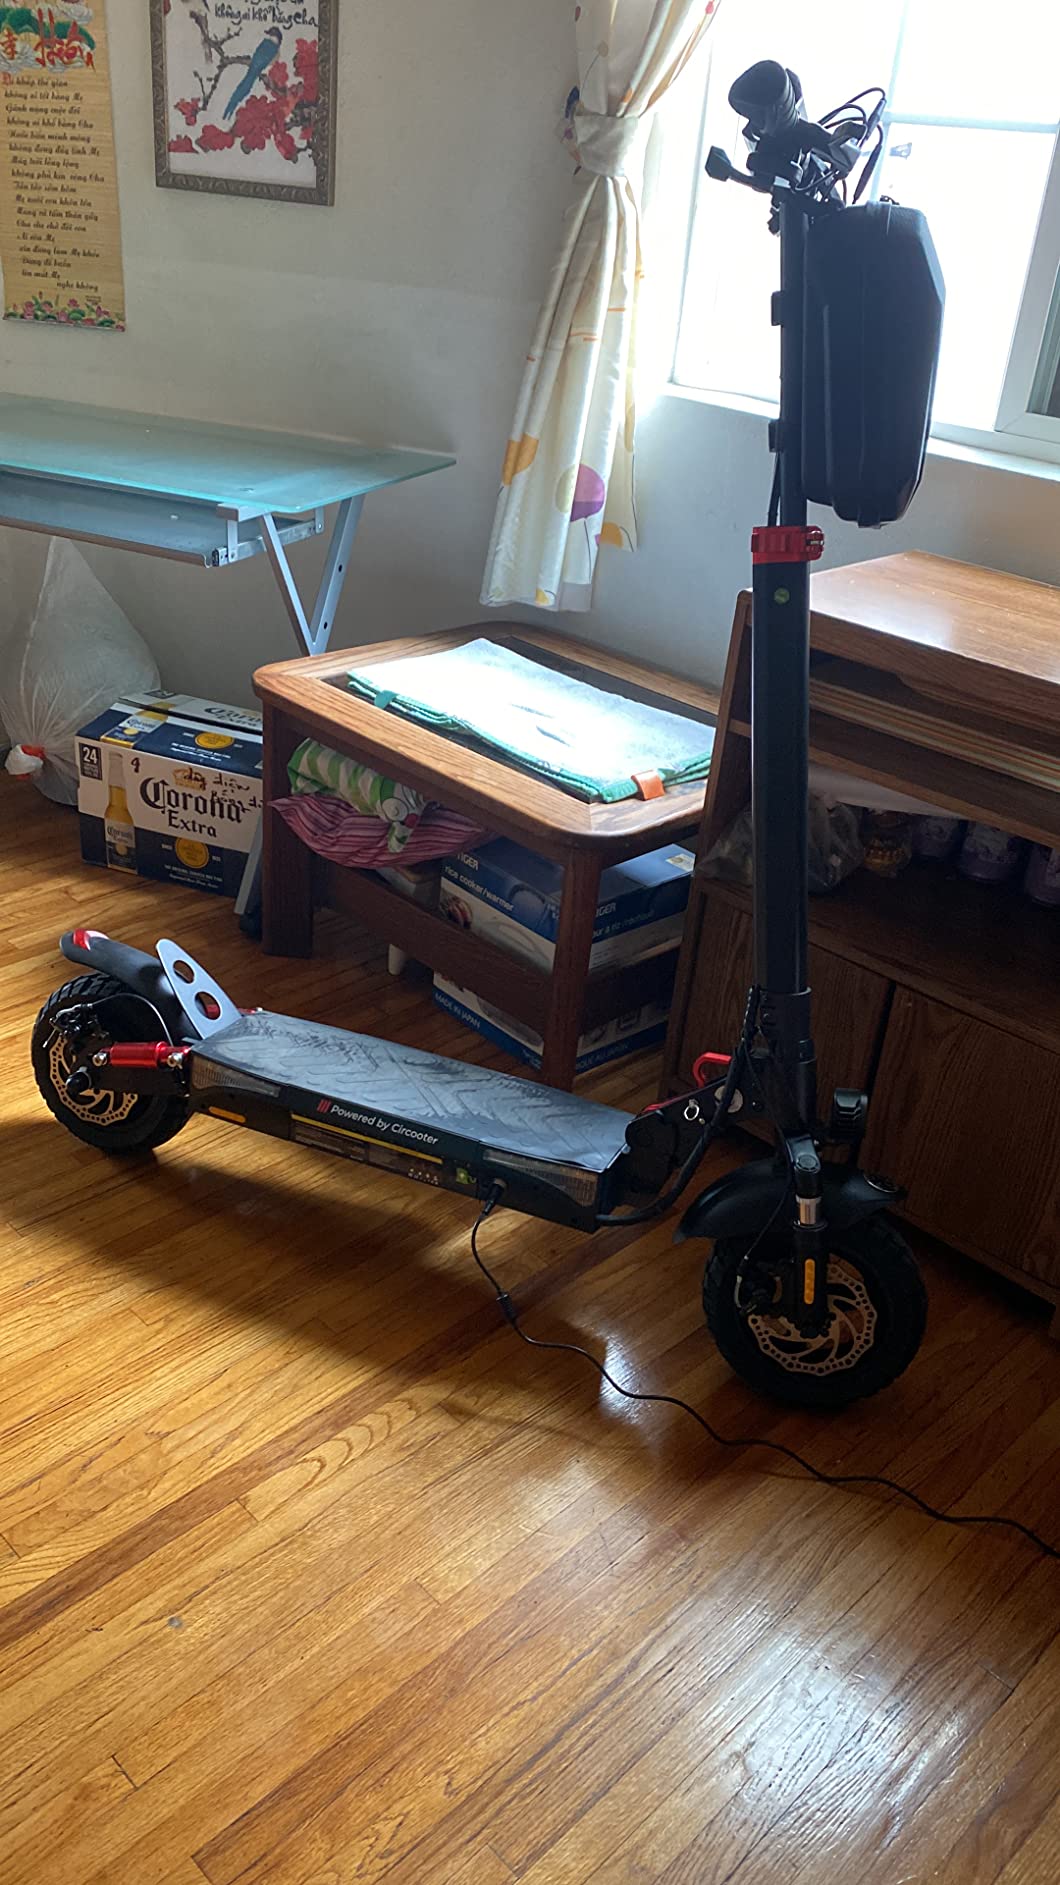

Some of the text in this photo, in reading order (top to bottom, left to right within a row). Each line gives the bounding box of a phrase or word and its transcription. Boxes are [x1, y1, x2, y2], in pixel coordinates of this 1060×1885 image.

[82, 746, 98, 764] 24
[139, 776, 242, 824] Corona
[167, 808, 217, 838] Extra
[444, 865, 459, 879] rice
[595, 902, 617, 918] IGER
[461, 1011, 481, 1029] JAPAN
[330, 1104, 439, 1145] Powered by Circooter
